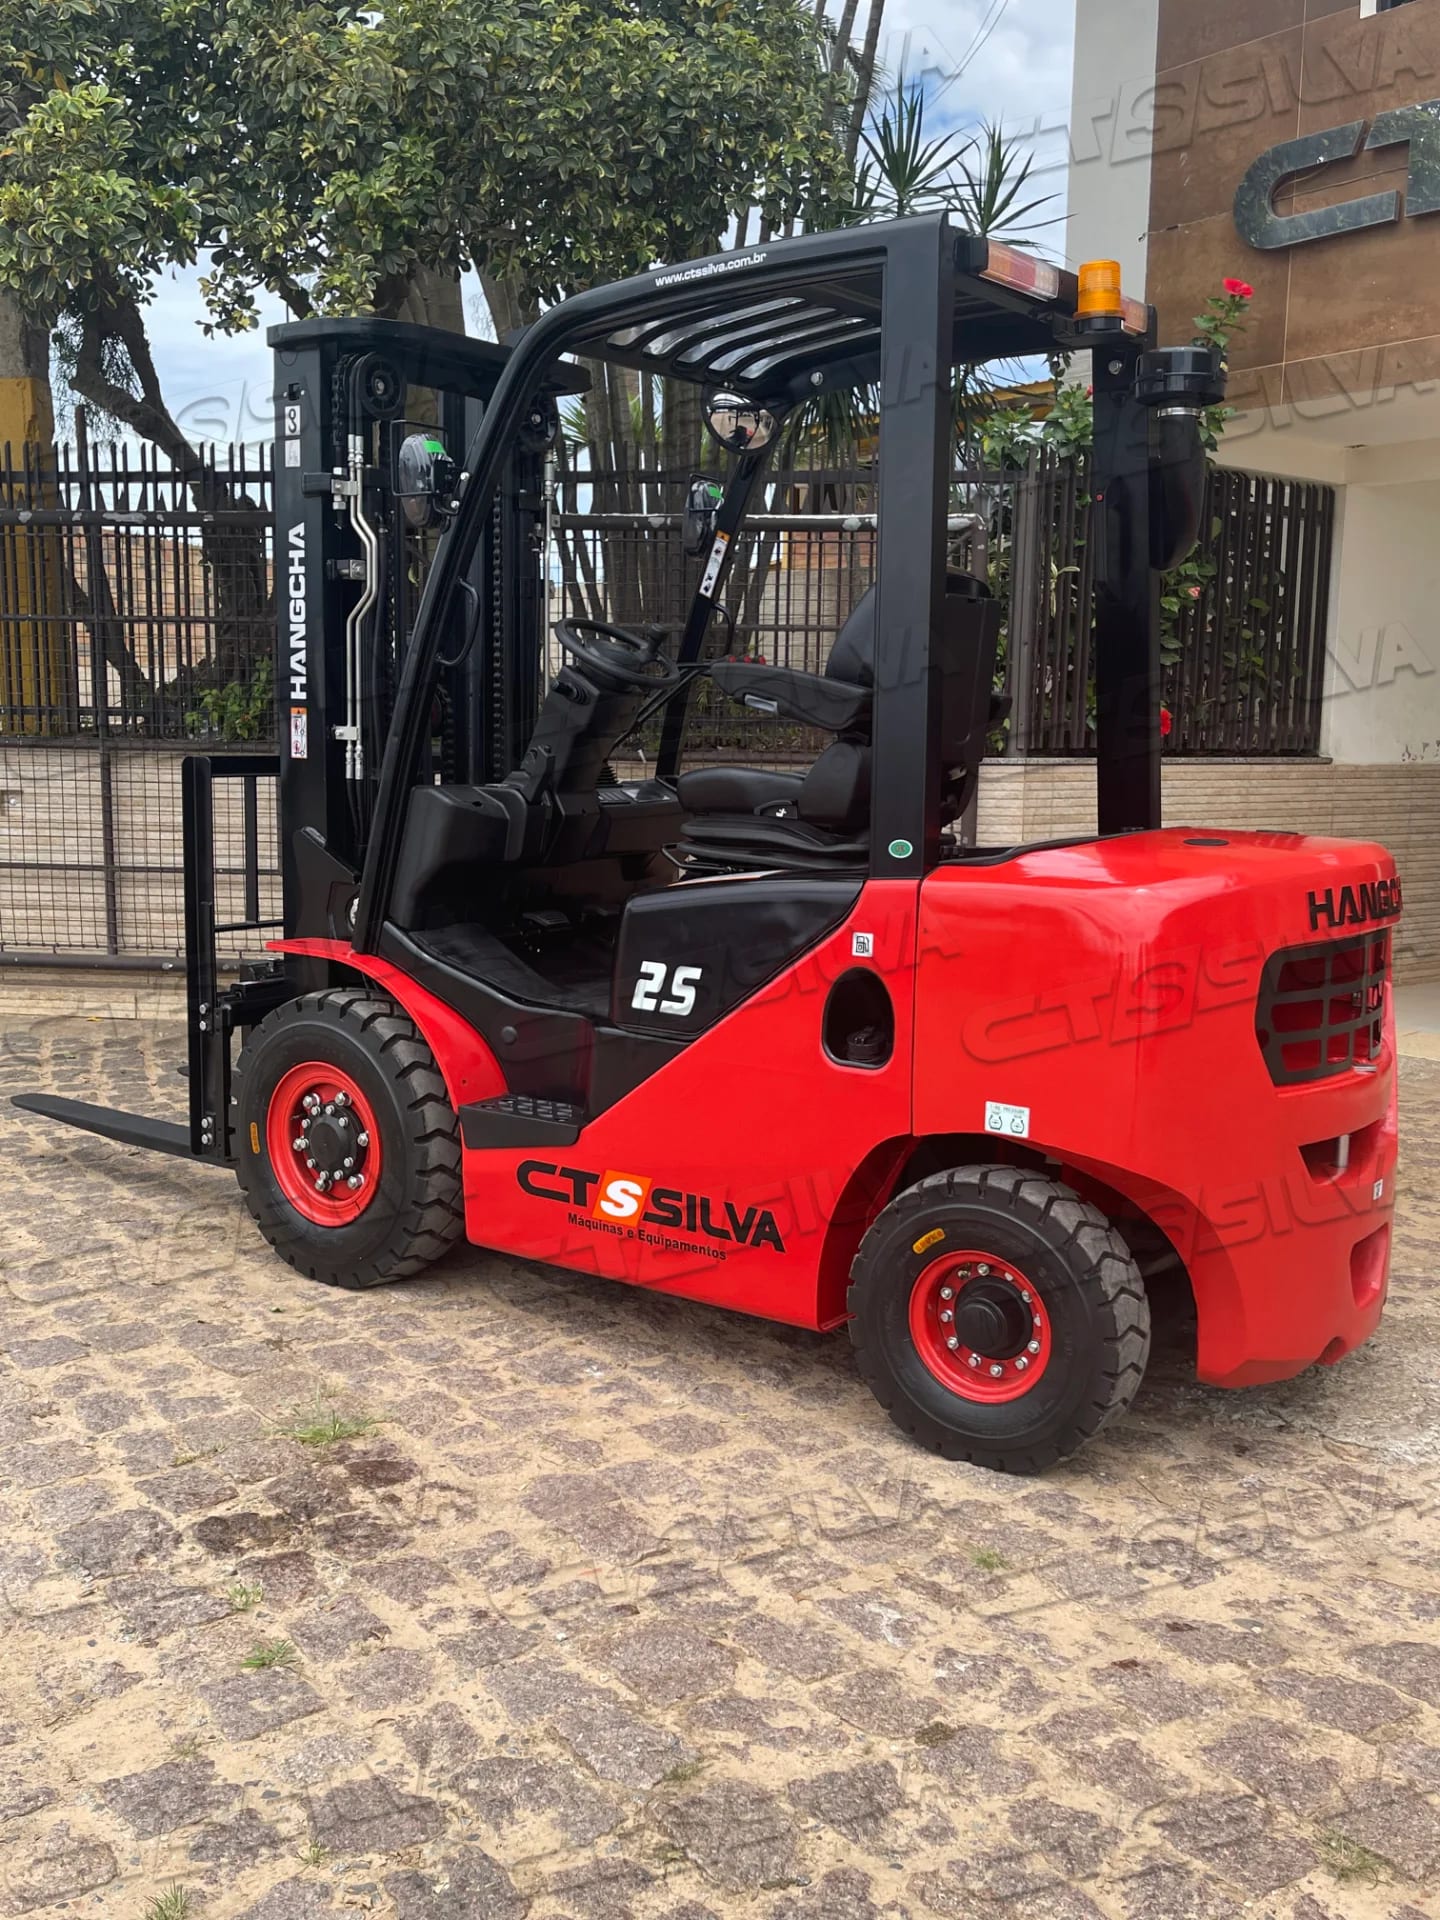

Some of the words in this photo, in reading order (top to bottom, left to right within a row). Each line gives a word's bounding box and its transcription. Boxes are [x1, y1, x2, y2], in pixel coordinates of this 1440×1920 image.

[655, 252, 767, 287] www.ctssilva.com.br
[288, 522, 307, 700] HANGCHA
[516, 1159, 786, 1253] CTSSILVA
[567, 1212, 623, 1237] Máquinas
[627, 1229, 635, 1240] e
[637, 1229, 728, 1261] Equipamentos
